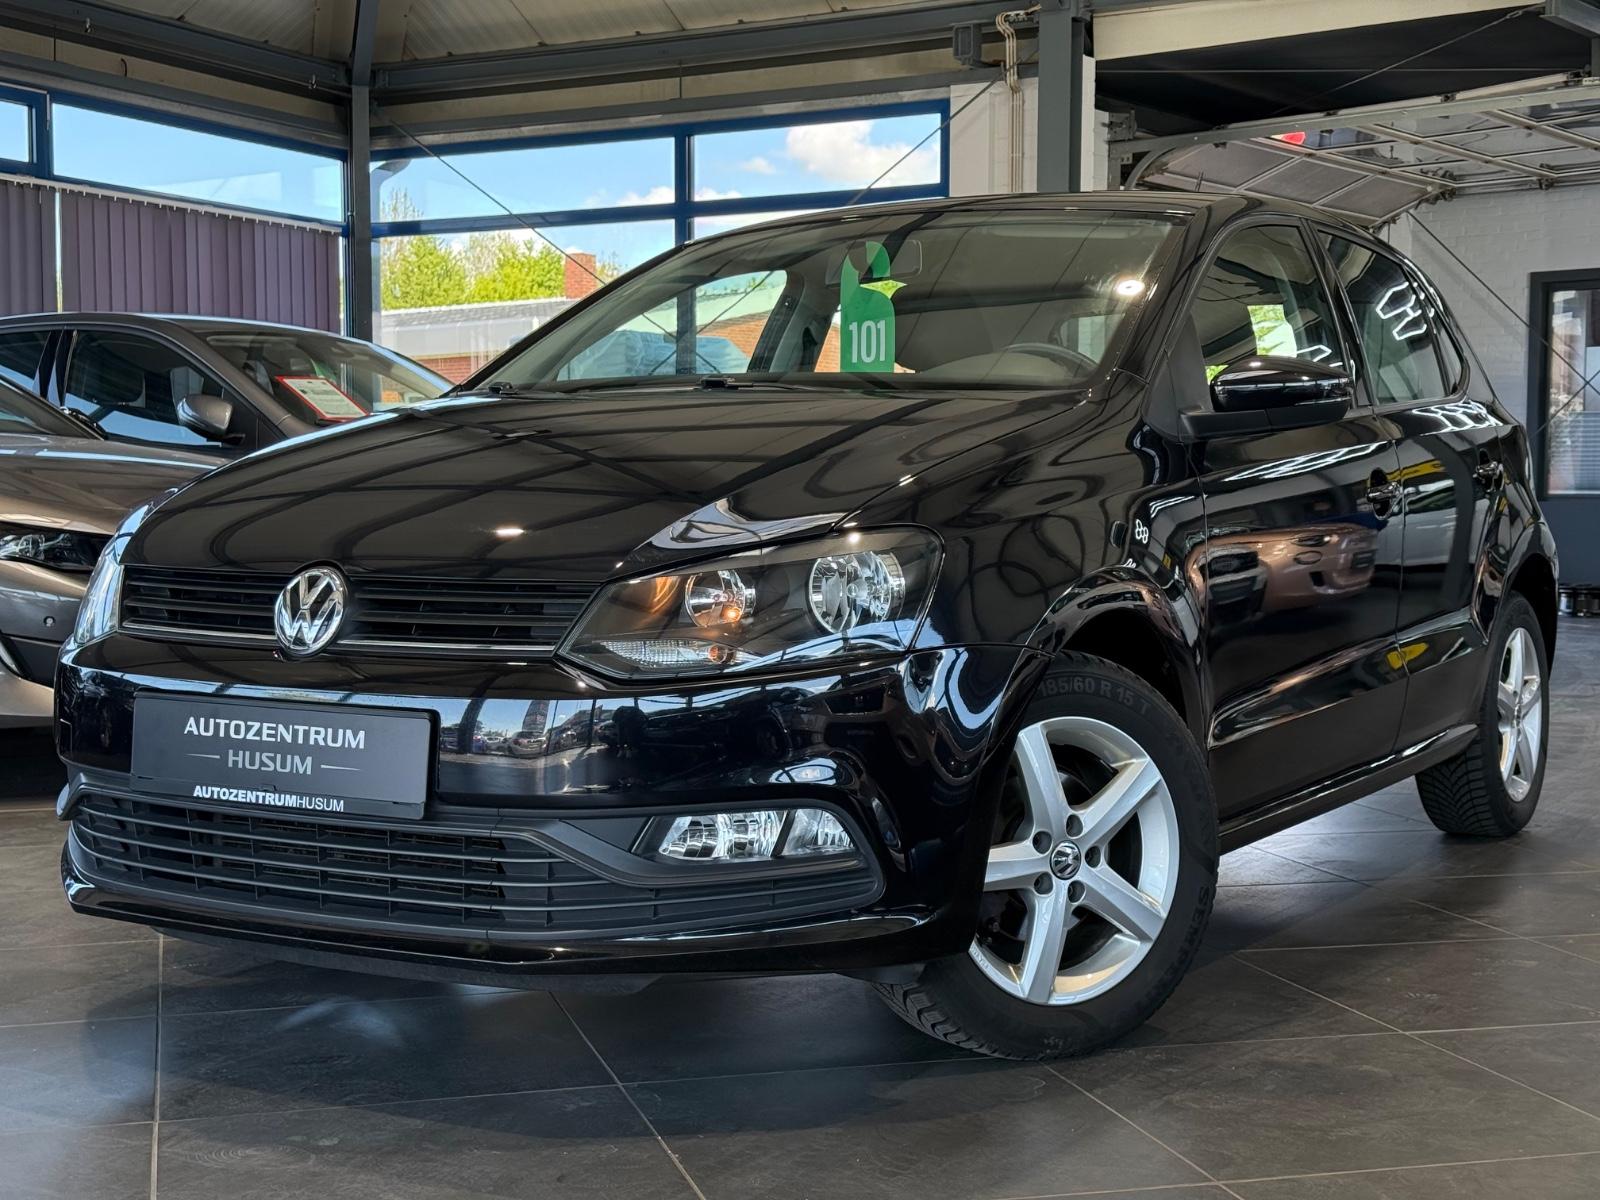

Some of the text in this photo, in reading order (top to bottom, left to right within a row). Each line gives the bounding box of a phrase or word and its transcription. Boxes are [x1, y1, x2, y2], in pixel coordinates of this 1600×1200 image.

[849, 319, 886, 364] 101
[1041, 676, 1096, 697] 185/60
[1101, 680, 1112, 698] R
[1116, 687, 1135, 706] 15
[184, 716, 365, 749] AUTOZENTRUM
[227, 749, 313, 775] HUSUM
